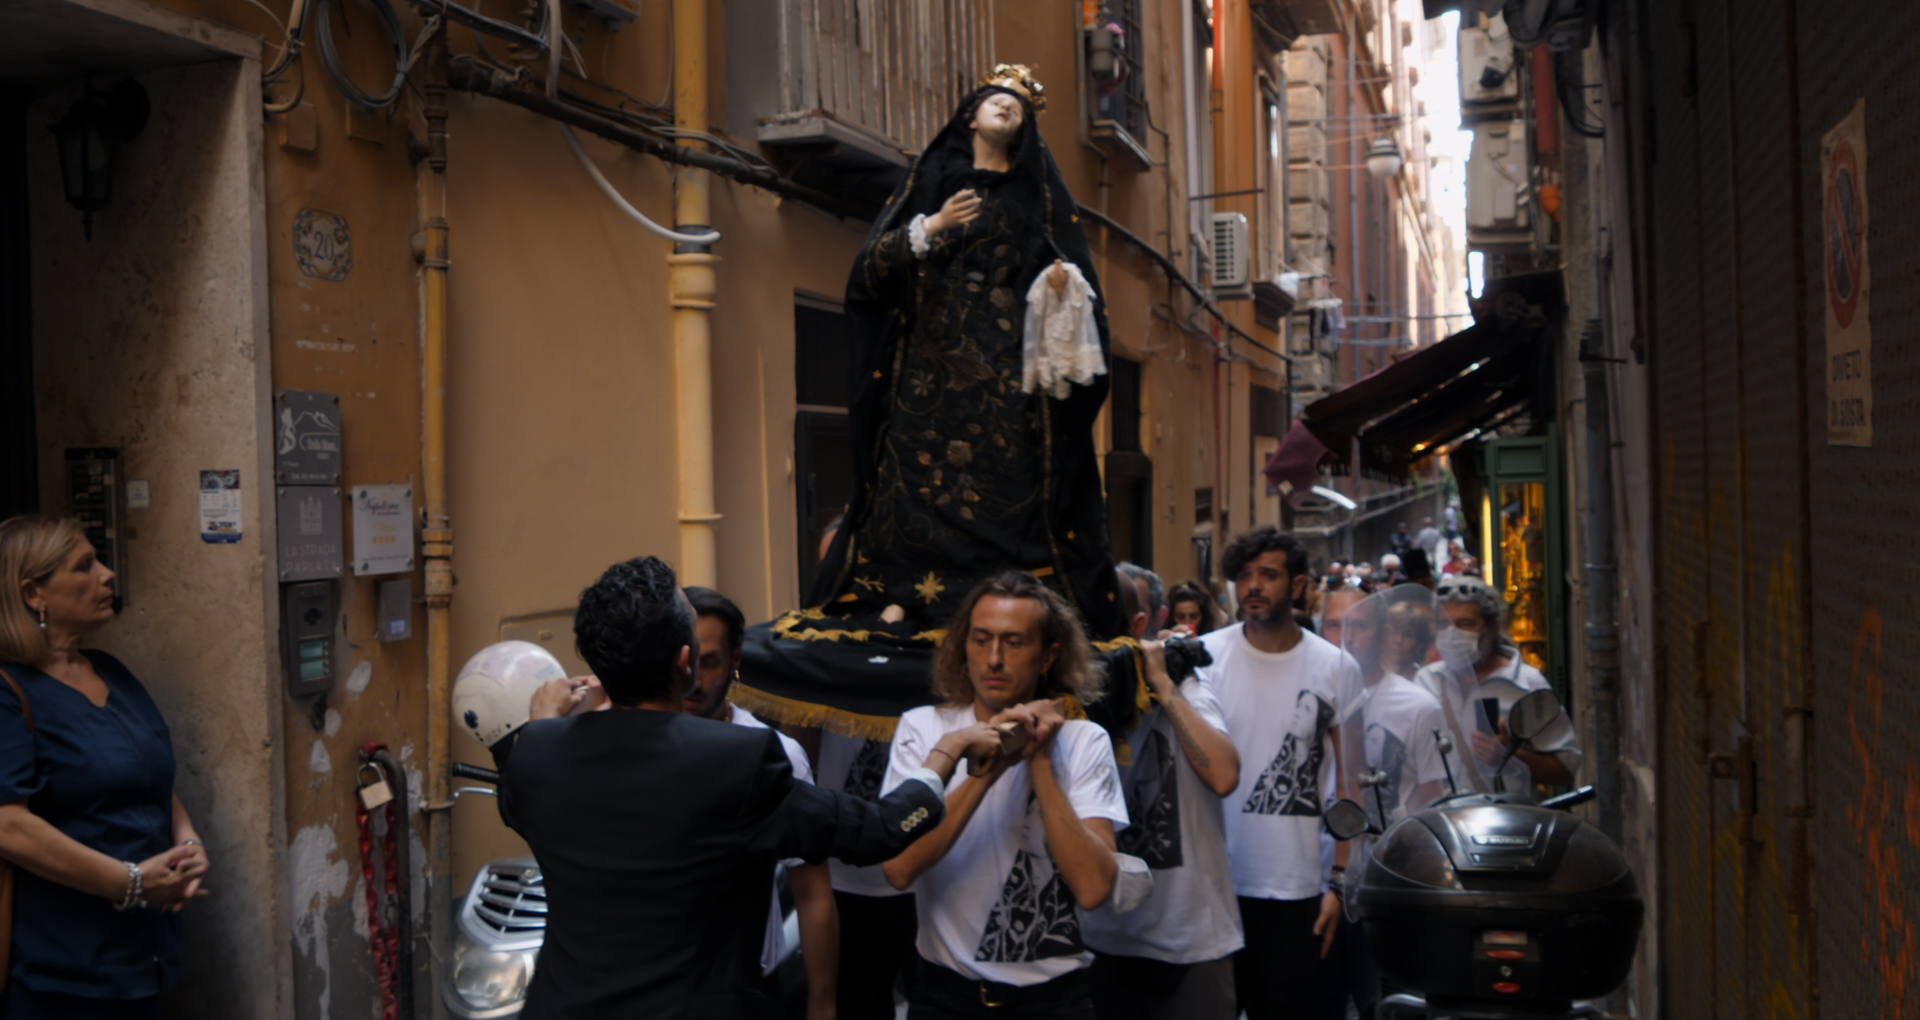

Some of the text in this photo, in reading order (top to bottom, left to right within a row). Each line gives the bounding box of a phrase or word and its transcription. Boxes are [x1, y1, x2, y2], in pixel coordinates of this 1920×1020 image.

[314, 231, 334, 261] 20
[1832, 350, 1861, 381] DIVETO
[1840, 399, 1865, 426] SOSTA
[285, 543, 337, 558] LA STRADA
